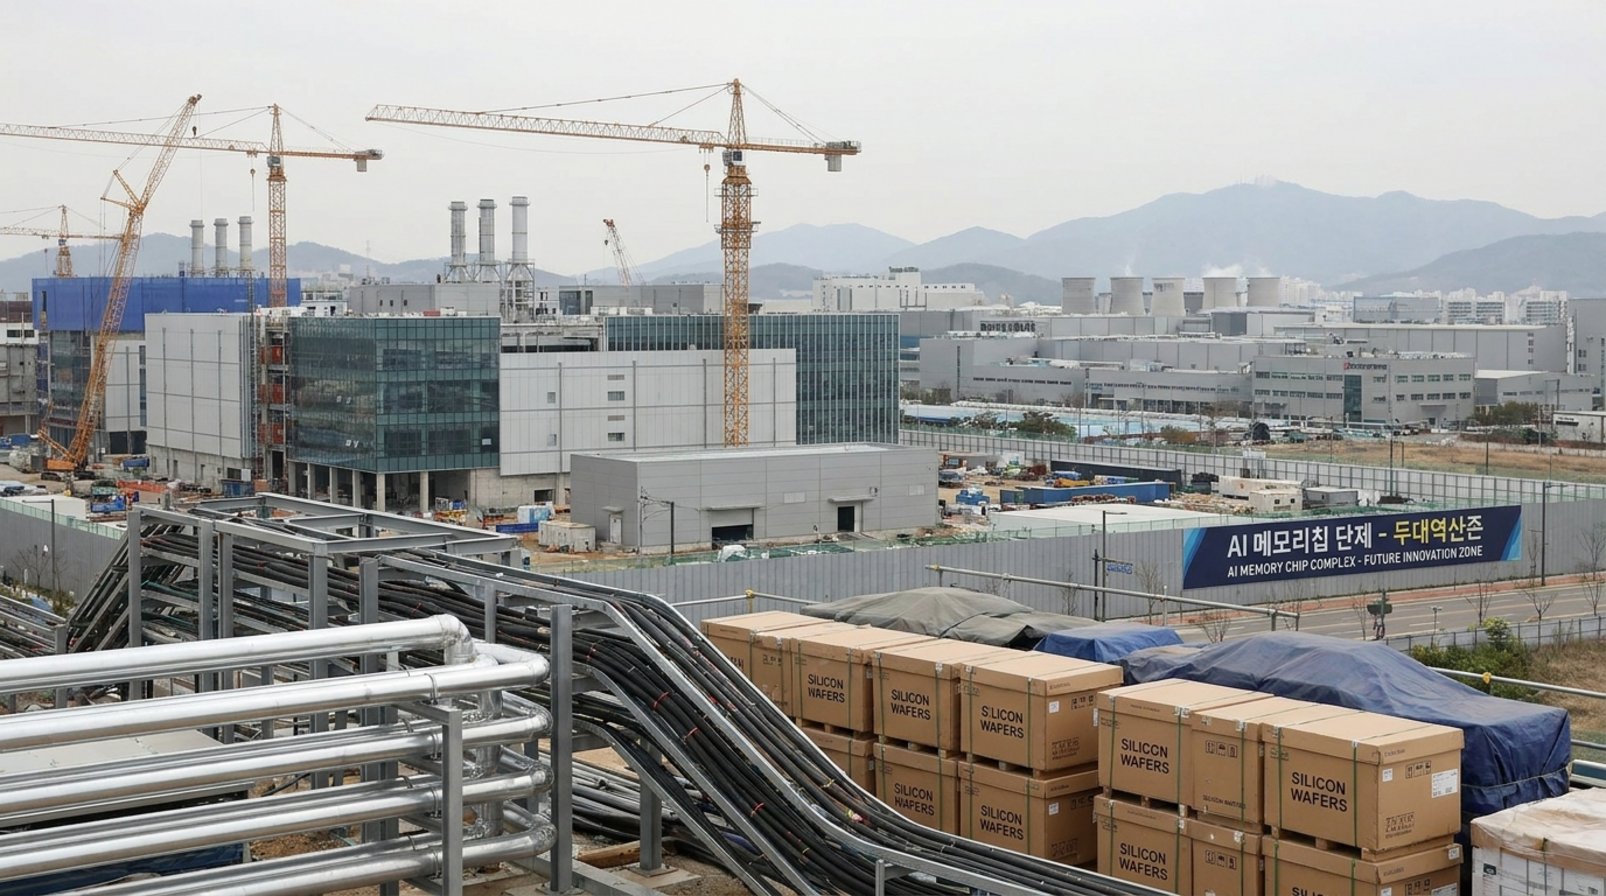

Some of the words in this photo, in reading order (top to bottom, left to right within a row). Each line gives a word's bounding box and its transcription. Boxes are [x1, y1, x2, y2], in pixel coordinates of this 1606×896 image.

[1227, 534, 1247, 558] AI
[1253, 525, 1329, 557] 메모리칩
[1227, 565, 1238, 578] AI
[1240, 562, 1283, 577] MEMORY
[1285, 560, 1309, 573] CHIP
[1310, 556, 1356, 571] COMPLEX
[1364, 552, 1401, 566] FUTURE
[1403, 548, 1458, 563] INNOVATION
[1459, 545, 1483, 558] ZONE
[808, 673, 844, 690] SILICON
[807, 687, 845, 703] WAFERS
[891, 689, 930, 706] SILICON
[890, 703, 931, 720] WAFERS
[981, 705, 1023, 724] SLICON
[1120, 753, 1169, 774] WAFERS
[894, 782, 933, 801] SILICON
[1291, 771, 1346, 795] SILICON
[1290, 788, 1348, 812] WAFERS
[980, 804, 1022, 825] SILICON
[980, 818, 1024, 840] WAFERS
[1120, 842, 1166, 865] SILICON
[1119, 857, 1168, 880] WAFERS
